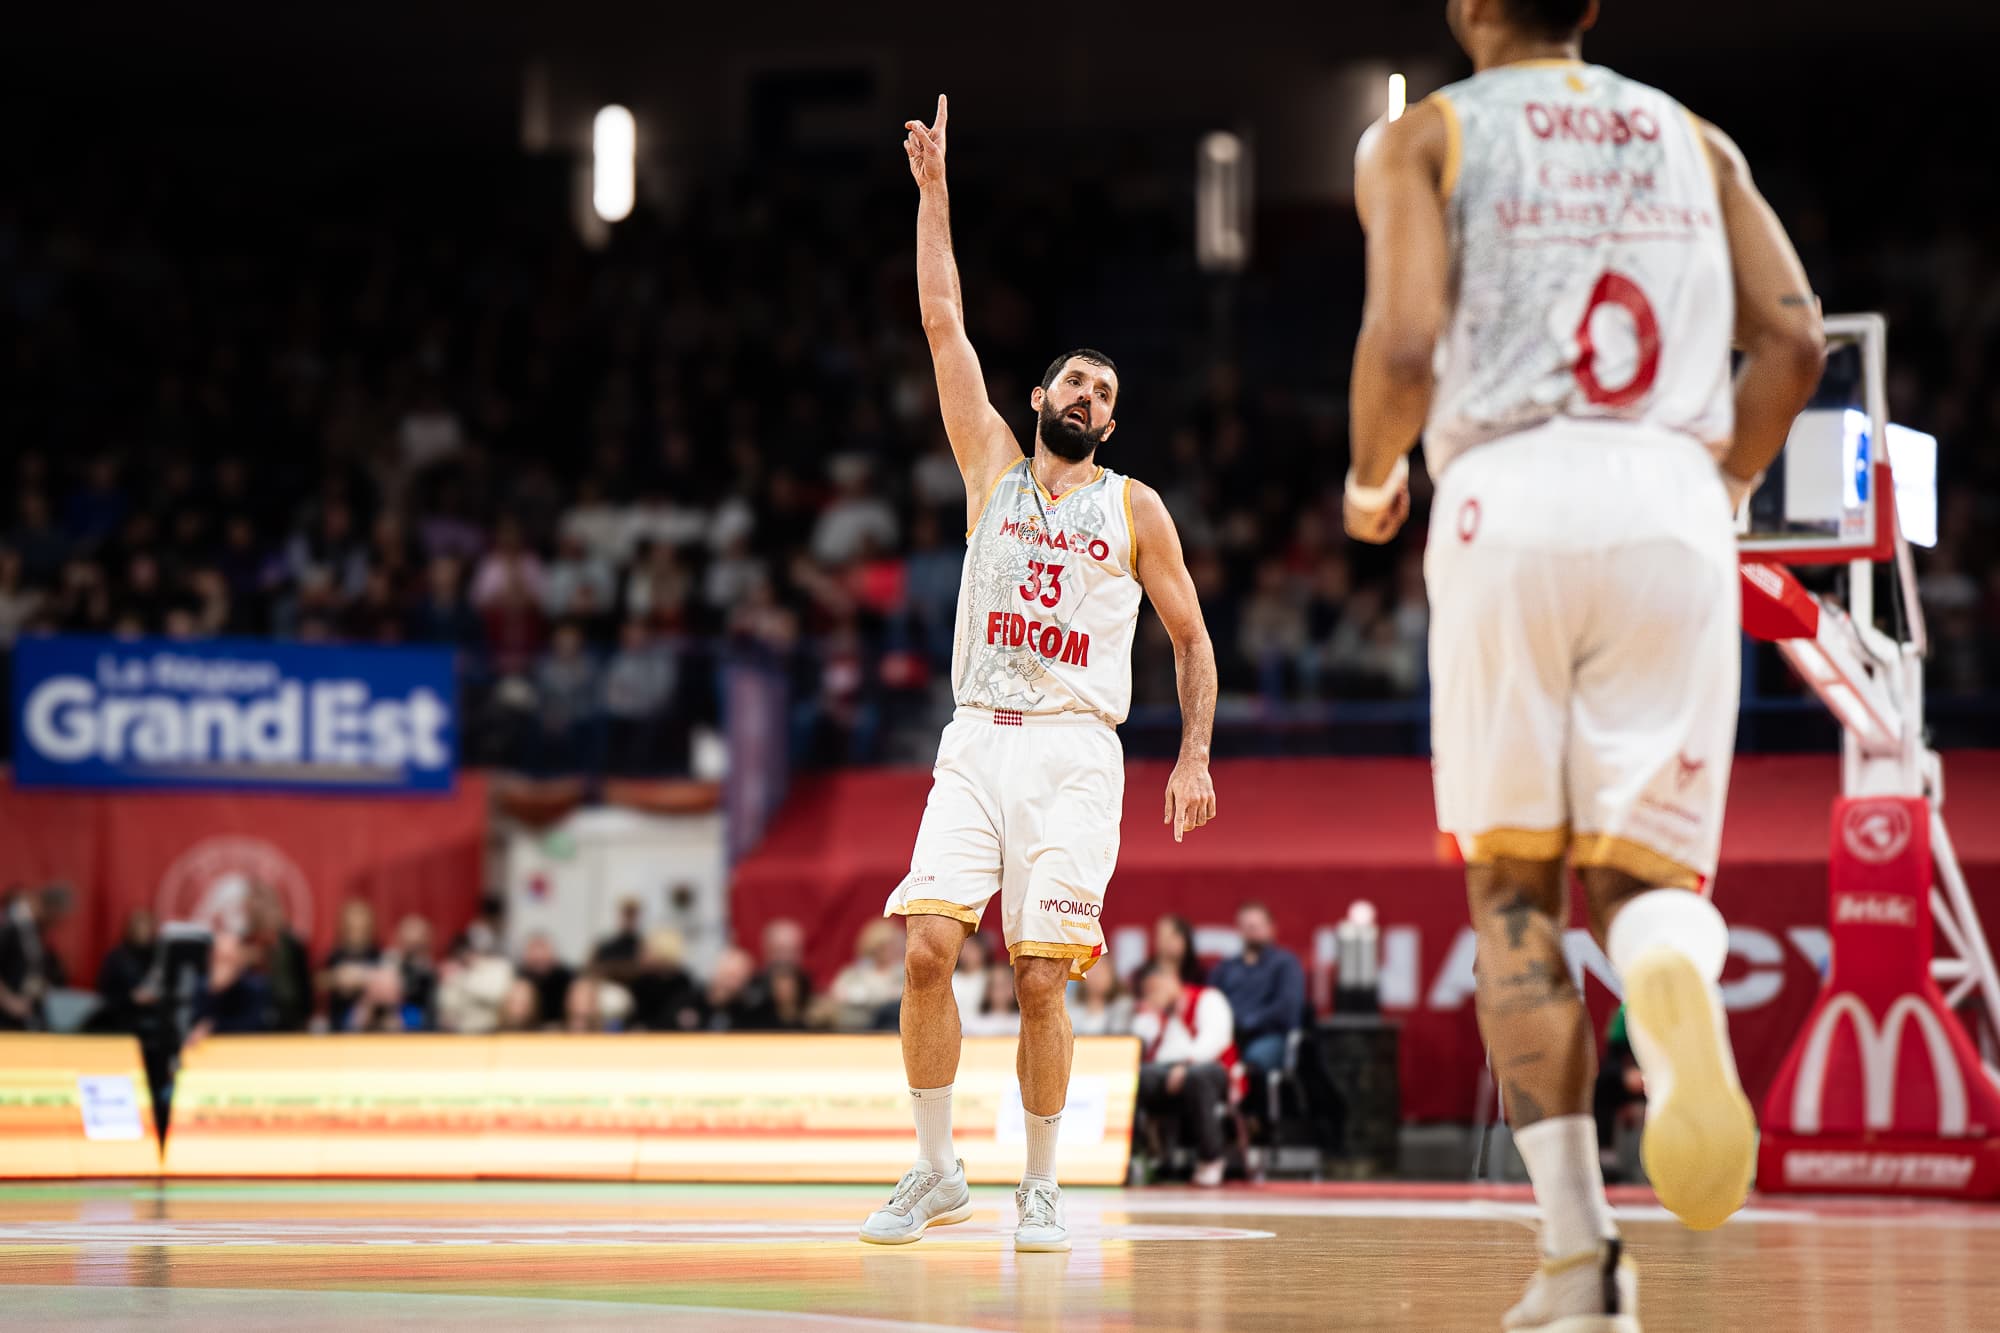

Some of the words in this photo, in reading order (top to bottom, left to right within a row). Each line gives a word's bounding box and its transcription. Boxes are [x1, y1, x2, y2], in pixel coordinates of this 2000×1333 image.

[1524, 102, 1661, 146] OKOBO
[1573, 269, 1662, 407] 0
[1018, 559, 1066, 609] 33
[986, 611, 1091, 668] FEDCOM
